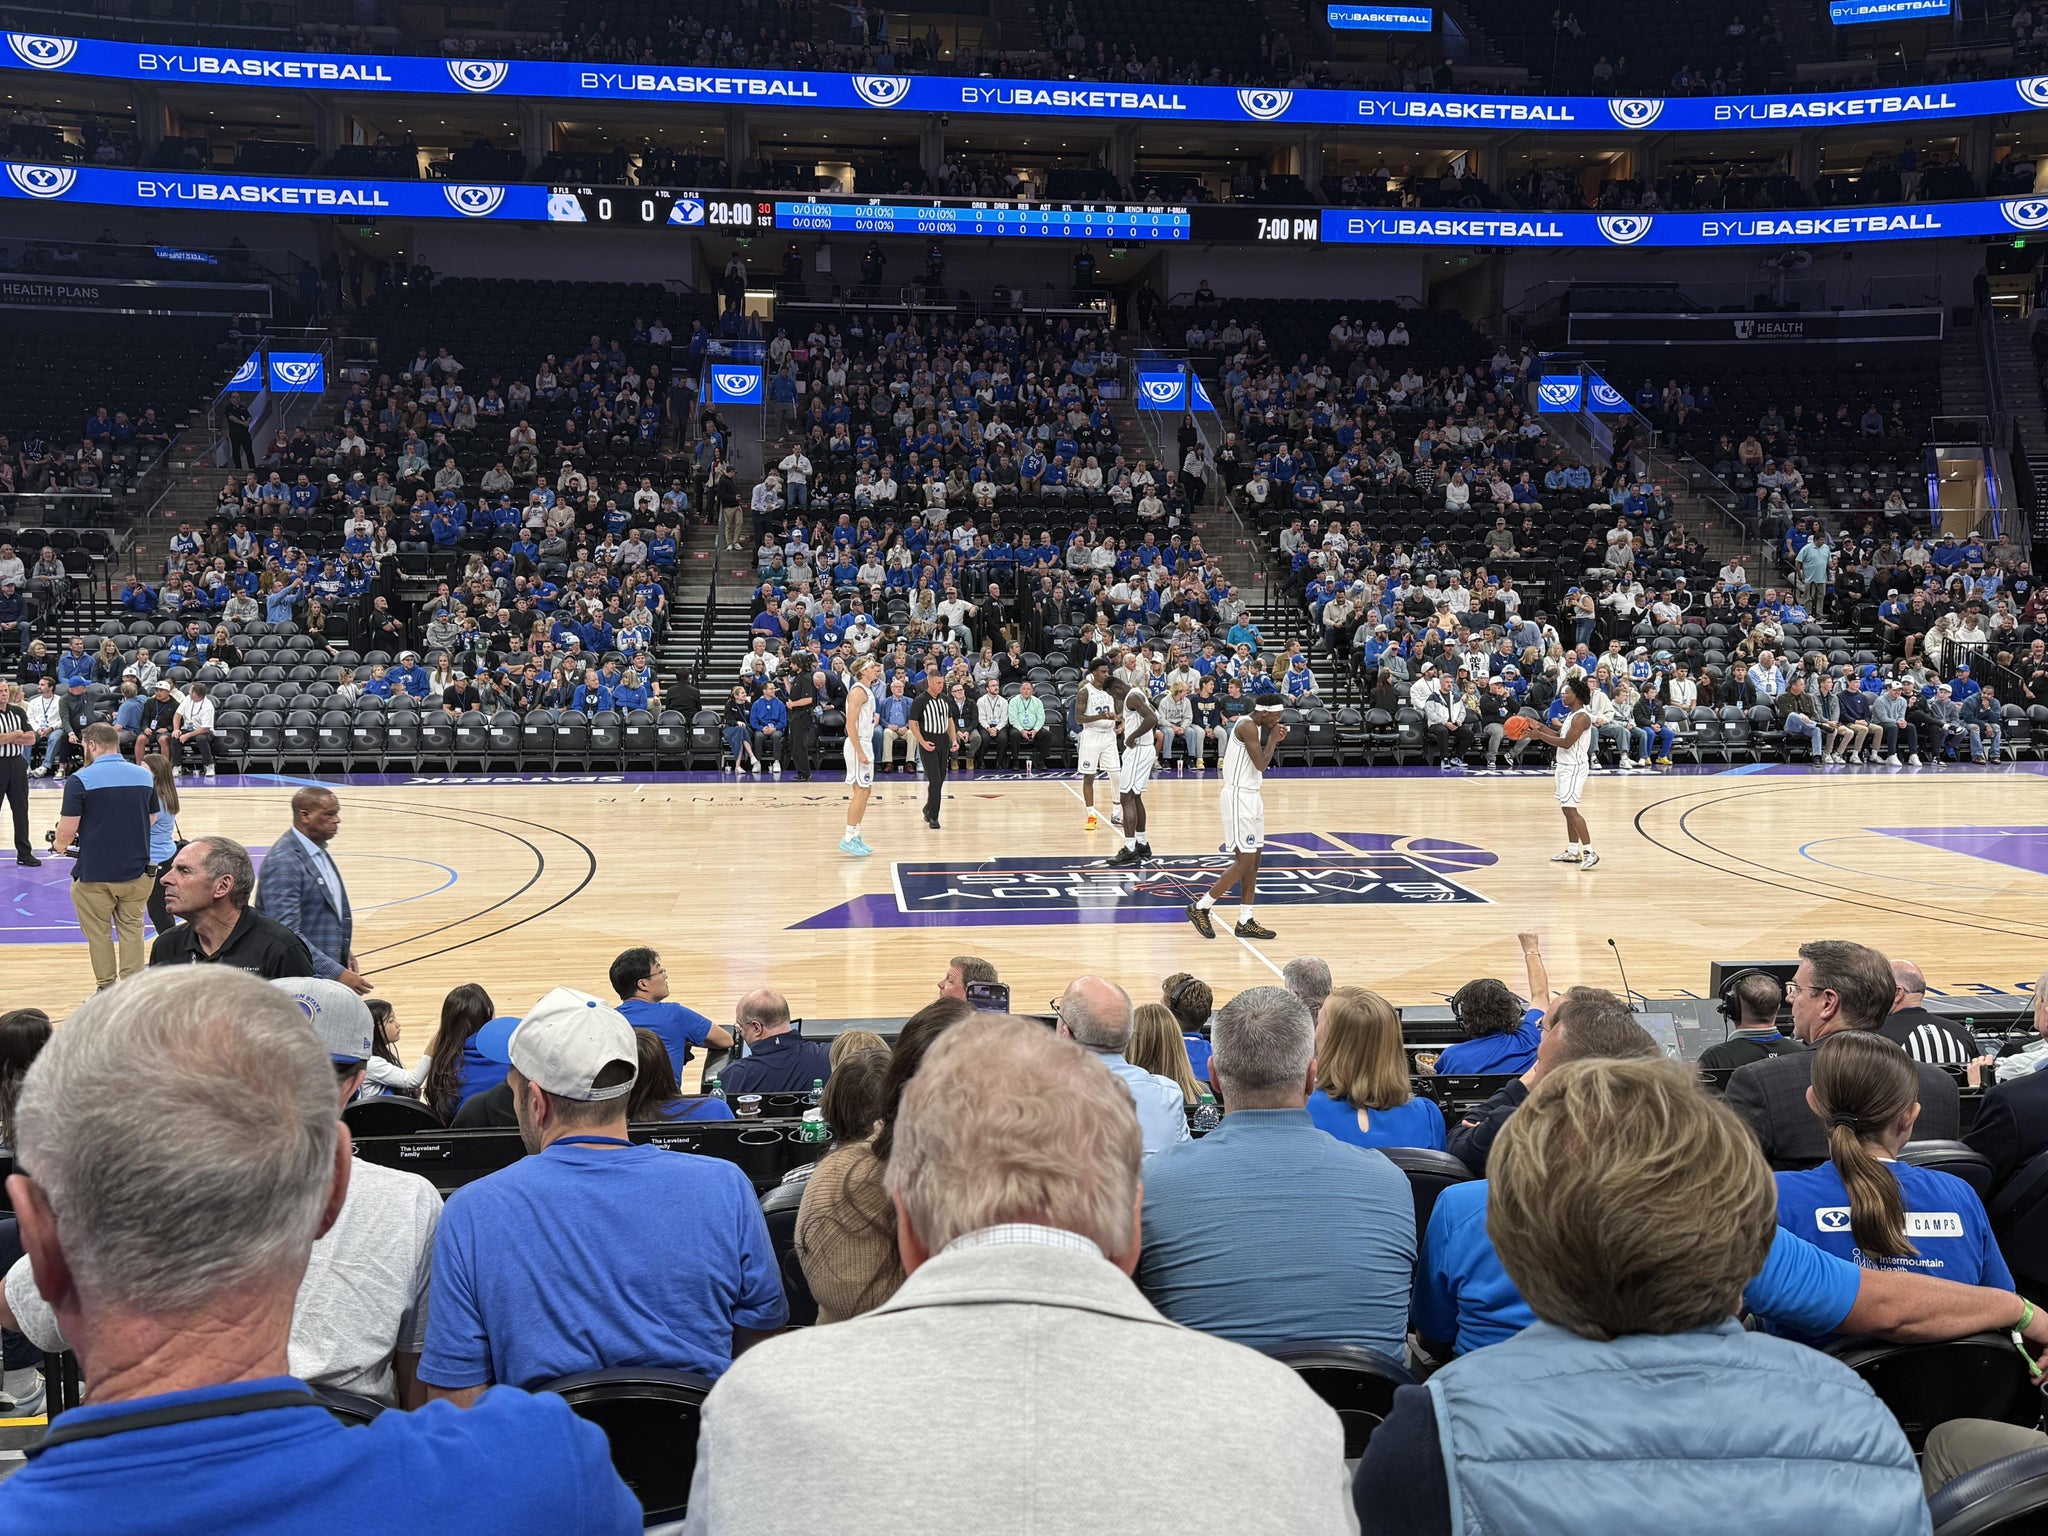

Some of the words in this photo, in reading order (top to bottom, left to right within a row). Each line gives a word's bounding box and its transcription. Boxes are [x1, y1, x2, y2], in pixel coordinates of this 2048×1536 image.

[1832, 0, 1947, 17] BYUBASKETBALL
[1330, 12, 1429, 24] BYUBASKETBALL
[138, 53, 392, 82] BYUBASKETBALL
[581, 72, 818, 97] BYUBASKETBALL
[962, 86, 1187, 110] BYUBASKETBALL
[1358, 100, 1575, 121] BYUBASKETBALL
[1714, 93, 1956, 120] BYUBASKETBALL
[137, 181, 389, 206] BYUBASKETBALL
[599, 198, 612, 220] 0
[641, 200, 654, 221] 0
[709, 202, 752, 225] 20:00
[758, 203, 771, 214] 30
[792, 205, 810, 215] 0/0
[812, 205, 832, 215] (0%)
[855, 207, 873, 217] 0/0
[874, 208, 894, 218] (0%)
[918, 209, 935, 219] 0/0
[937, 209, 956, 220] (0%)
[976, 211, 982, 220] 0
[998, 211, 1004, 221] 0
[1020, 212, 1026, 221] 0
[1042, 212, 1048, 222] 0
[1063, 213, 1070, 222] 0
[1085, 214, 1092, 223] 0
[1107, 214, 1114, 224] 0
[1130, 215, 1137, 224] 0
[1152, 215, 1158, 225] 0
[757, 216, 773, 226] 1ST
[792, 218, 810, 228] 0/0
[812, 218, 832, 229] (0%)
[855, 220, 873, 230] 0/0
[874, 220, 894, 231] (0%)
[1173, 216, 1180, 225] 0
[1702, 213, 1942, 237] BYUBASKETBALL
[918, 222, 935, 232] 0/0
[937, 222, 956, 233] (0%)
[976, 224, 982, 233] 0
[998, 224, 1004, 234] 0
[1020, 225, 1026, 234] 0
[1042, 225, 1048, 235] 0
[1063, 226, 1070, 235] 0
[1085, 226, 1092, 236] 0
[1107, 227, 1114, 236] 0
[1130, 227, 1136, 237] 0
[1152, 228, 1158, 237] 0
[1173, 228, 1180, 238] 0
[1258, 218, 1289, 240] 7:00
[1293, 219, 1318, 240] PM
[1348, 218, 1564, 237] BYUBASKETBALL
[2, 283, 53, 297] HEALTH
[57, 286, 100, 299] PLANS
[1757, 322, 1803, 333] HEALTH
[1149, 680, 1165, 688] BYU
[918, 886, 1129, 901] BOY
[305, 995, 322, 1014] STATE
[1914, 1218, 1956, 1231] CAMPS
[1879, 1255, 1944, 1269] Intermountain
